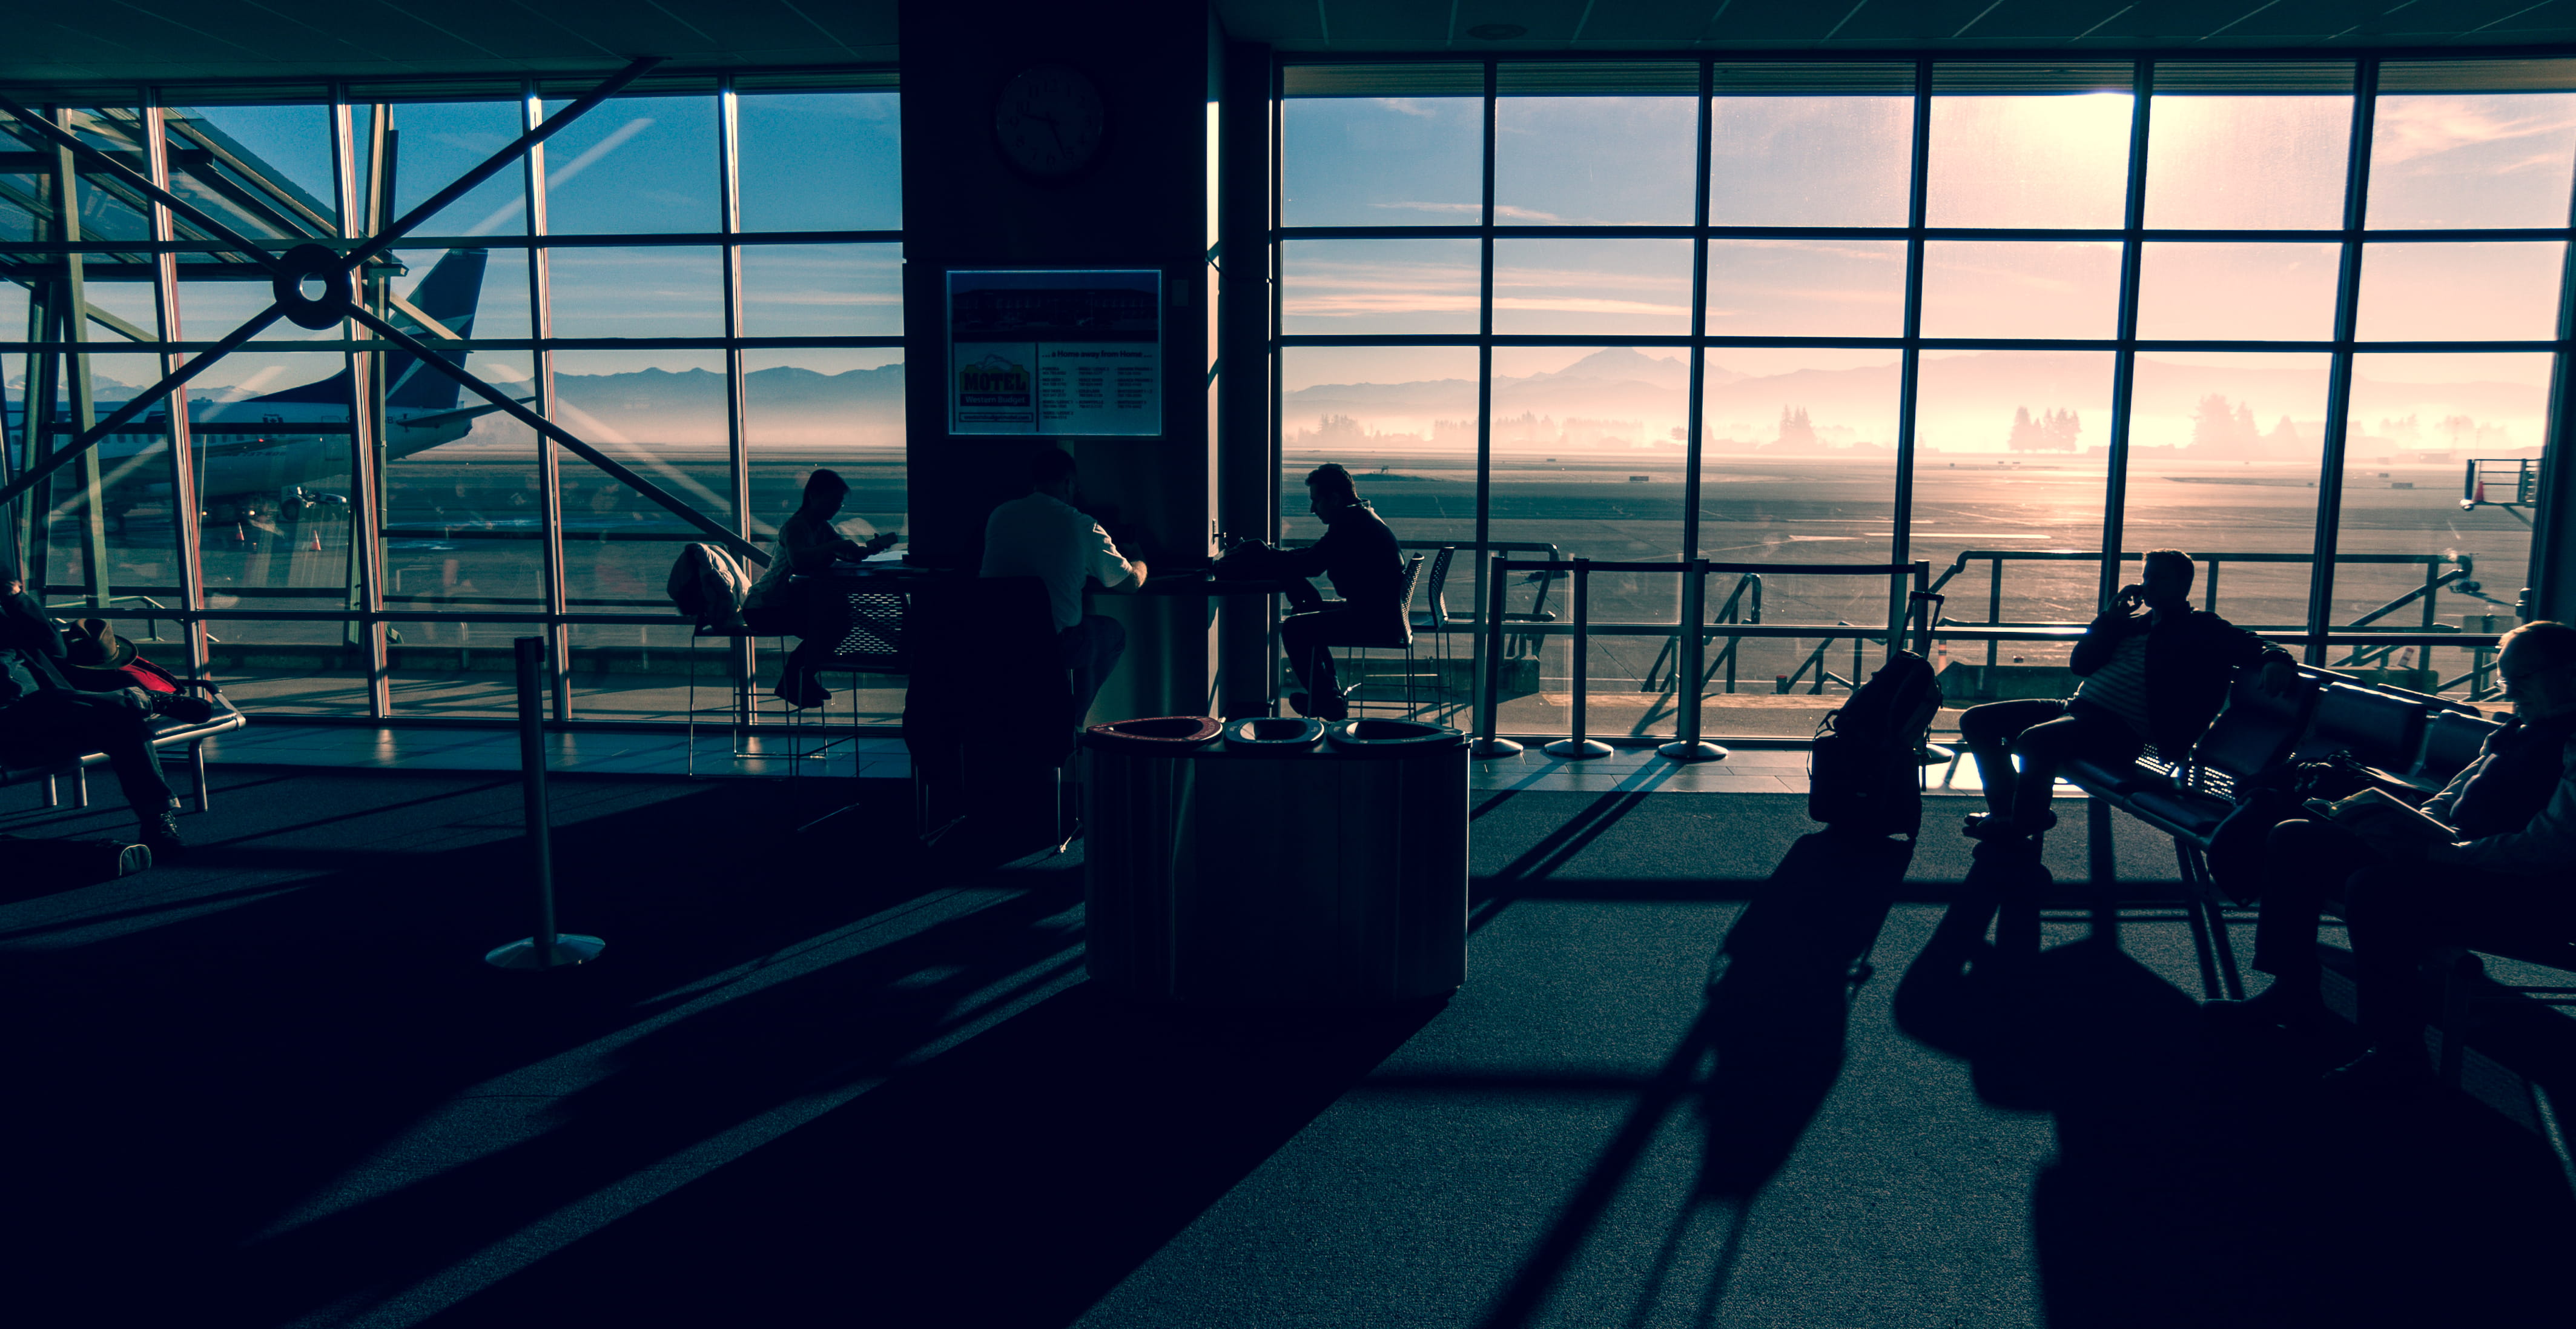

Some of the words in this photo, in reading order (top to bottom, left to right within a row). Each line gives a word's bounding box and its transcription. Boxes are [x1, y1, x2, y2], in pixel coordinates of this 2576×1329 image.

[1057, 350, 1079, 358] Home
[1101, 350, 1118, 358] from
[964, 373, 1026, 391] MOTEL
[965, 395, 997, 403] Western
[997, 395, 1025, 405] Budget
